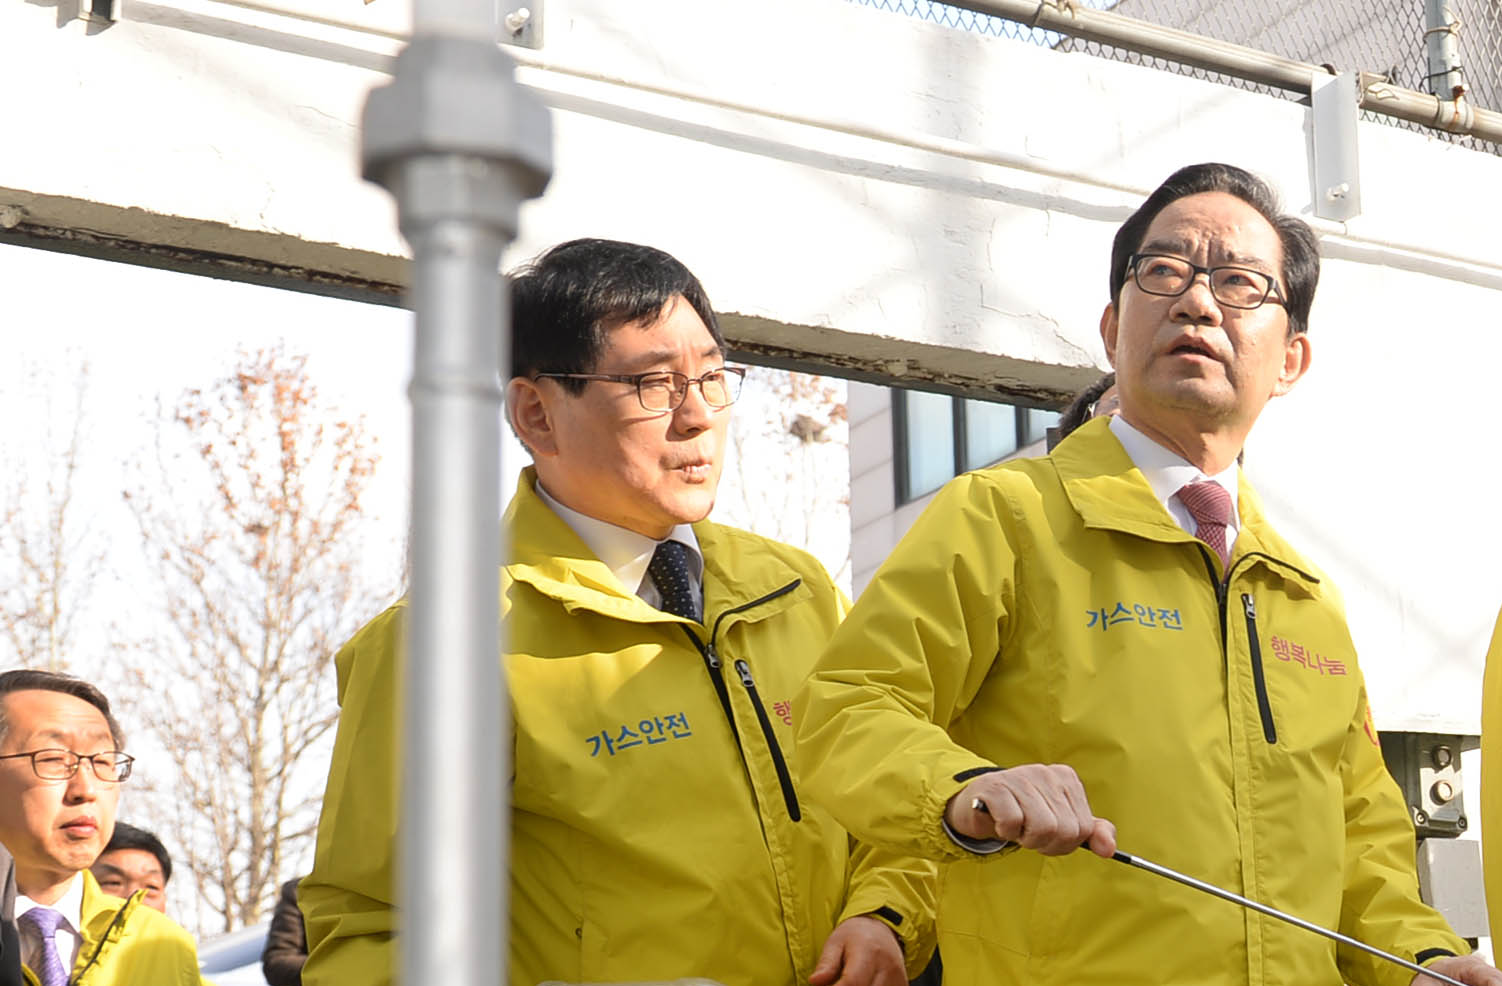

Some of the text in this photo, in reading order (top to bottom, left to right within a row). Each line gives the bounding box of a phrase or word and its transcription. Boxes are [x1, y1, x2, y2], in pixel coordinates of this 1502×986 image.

[1085, 602, 1184, 632] 가스안전
[1270, 635, 1347, 676] 행복나눔
[585, 711, 692, 757] 가스안전
